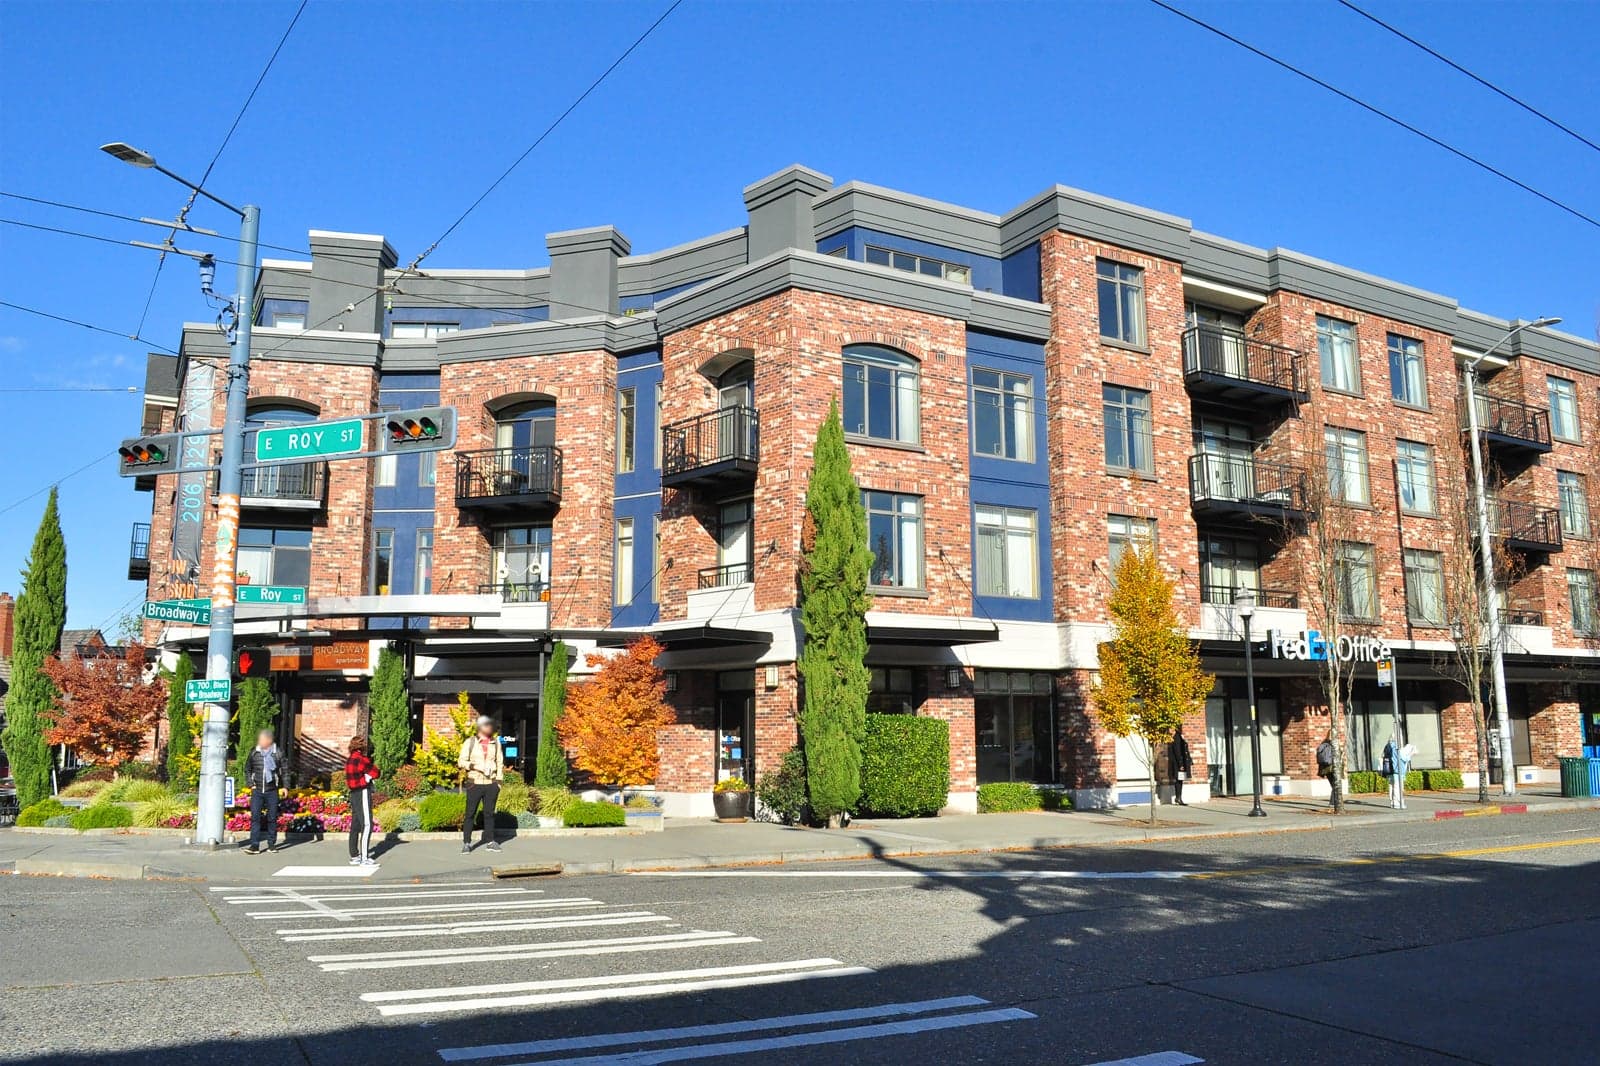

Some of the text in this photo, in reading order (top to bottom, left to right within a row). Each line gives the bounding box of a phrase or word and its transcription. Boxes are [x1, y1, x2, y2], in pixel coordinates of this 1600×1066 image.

[265, 429, 355, 450] E ROY ST
[240, 591, 247, 600] E
[261, 588, 282, 602] Roy
[147, 603, 200, 623] Broadway
[203, 612, 209, 622] E
[314, 645, 365, 656] BROADWAY
[1336, 634, 1392, 662] Office
[336, 657, 366, 665] apartments
[196, 681, 210, 690] 700
